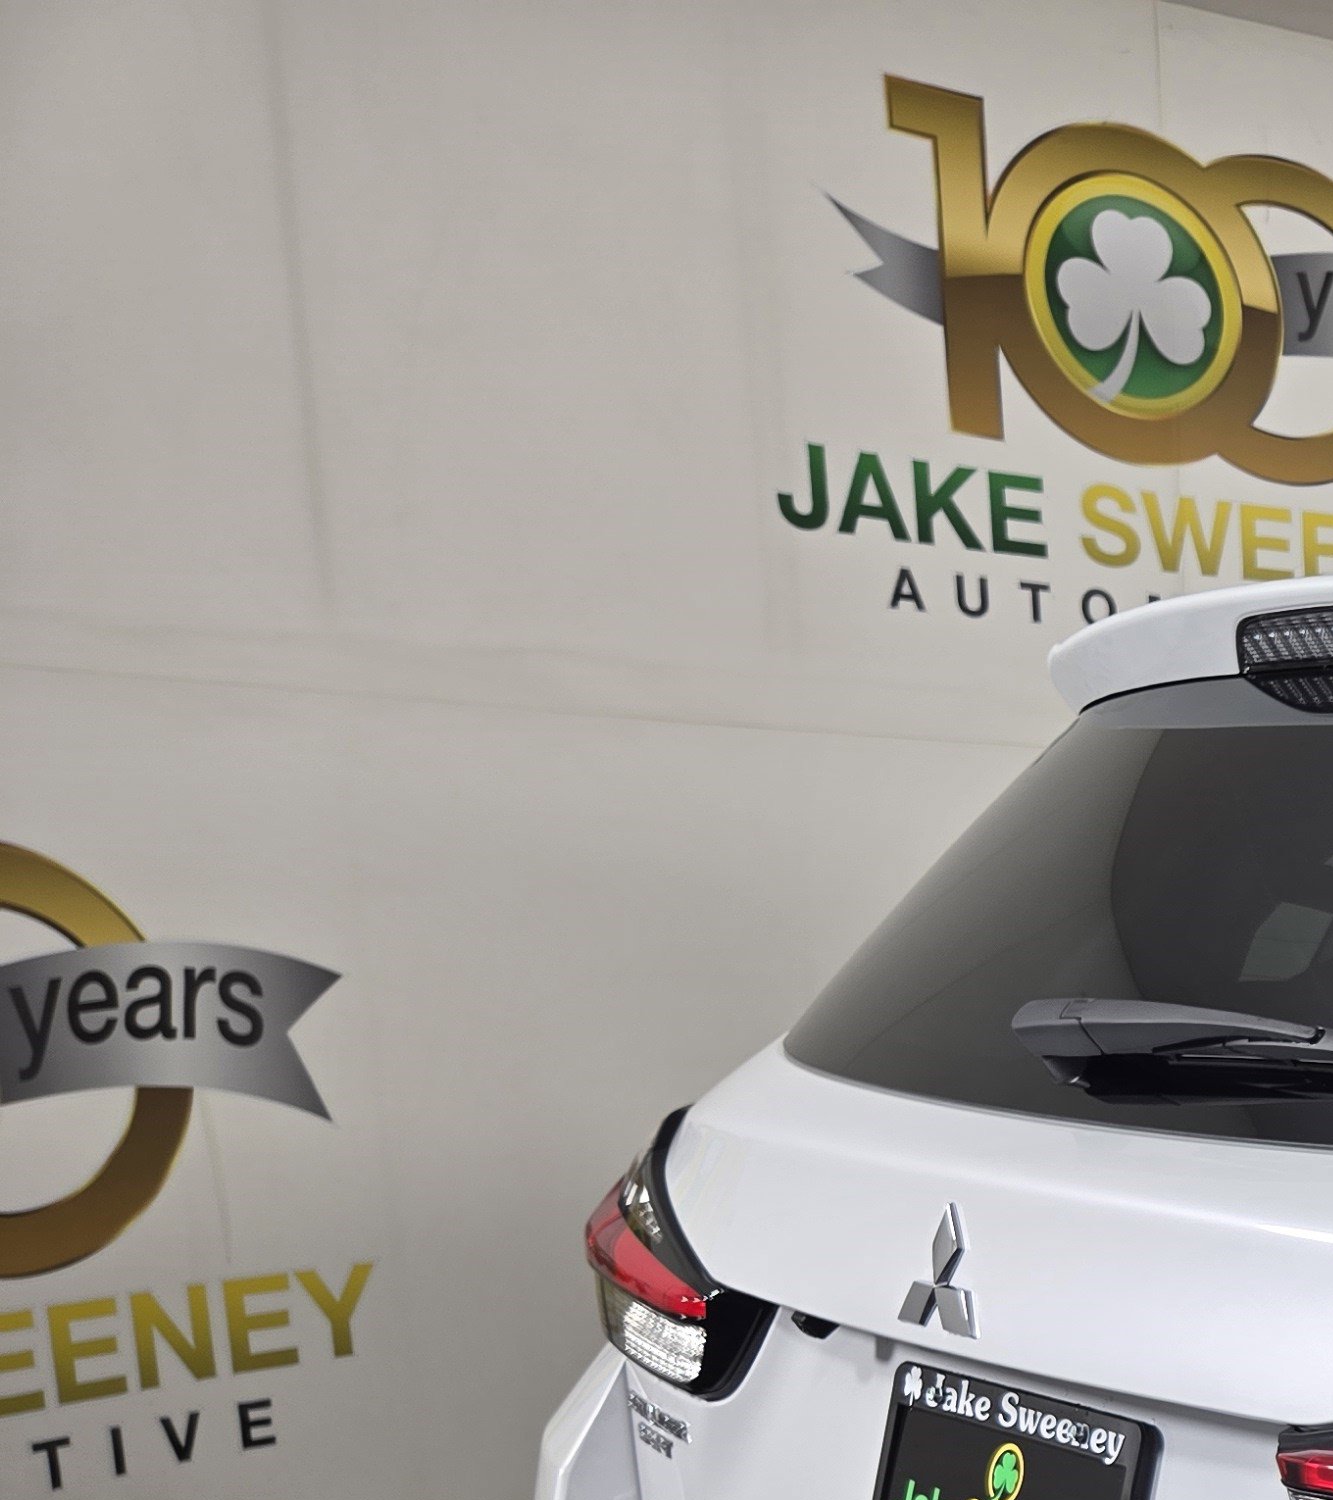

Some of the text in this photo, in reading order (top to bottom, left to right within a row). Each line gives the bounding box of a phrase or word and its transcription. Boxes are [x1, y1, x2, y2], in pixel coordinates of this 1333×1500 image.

[777, 442, 1048, 559] JAKE
[889, 566, 1172, 625] AUTO
[6, 963, 265, 1083] years
[925, 1372, 1126, 1466] Jake Sweeney
